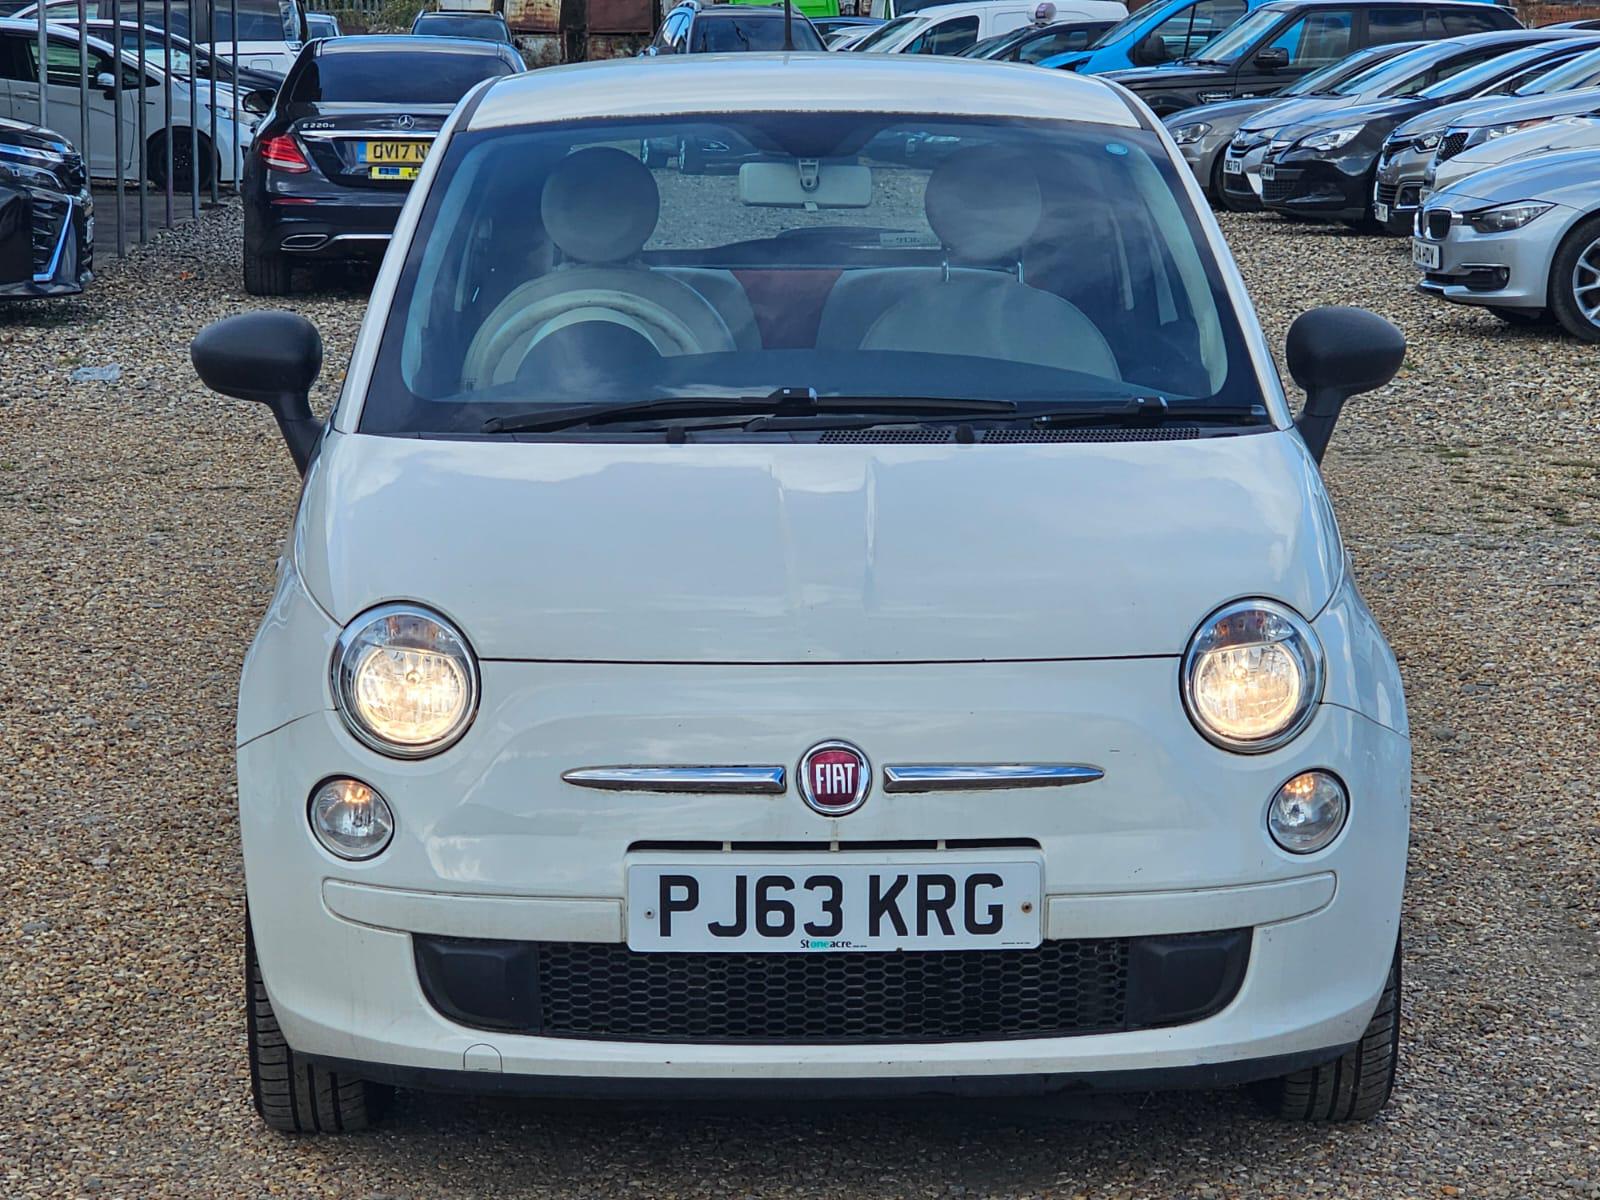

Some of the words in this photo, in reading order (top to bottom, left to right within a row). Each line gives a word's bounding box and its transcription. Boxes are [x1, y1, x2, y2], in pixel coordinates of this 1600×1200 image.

[815, 763, 856, 795] FIAT
[659, 874, 844, 938] PJ63
[868, 873, 1004, 937] KRG
[800, 939, 852, 949] Stoneacre
